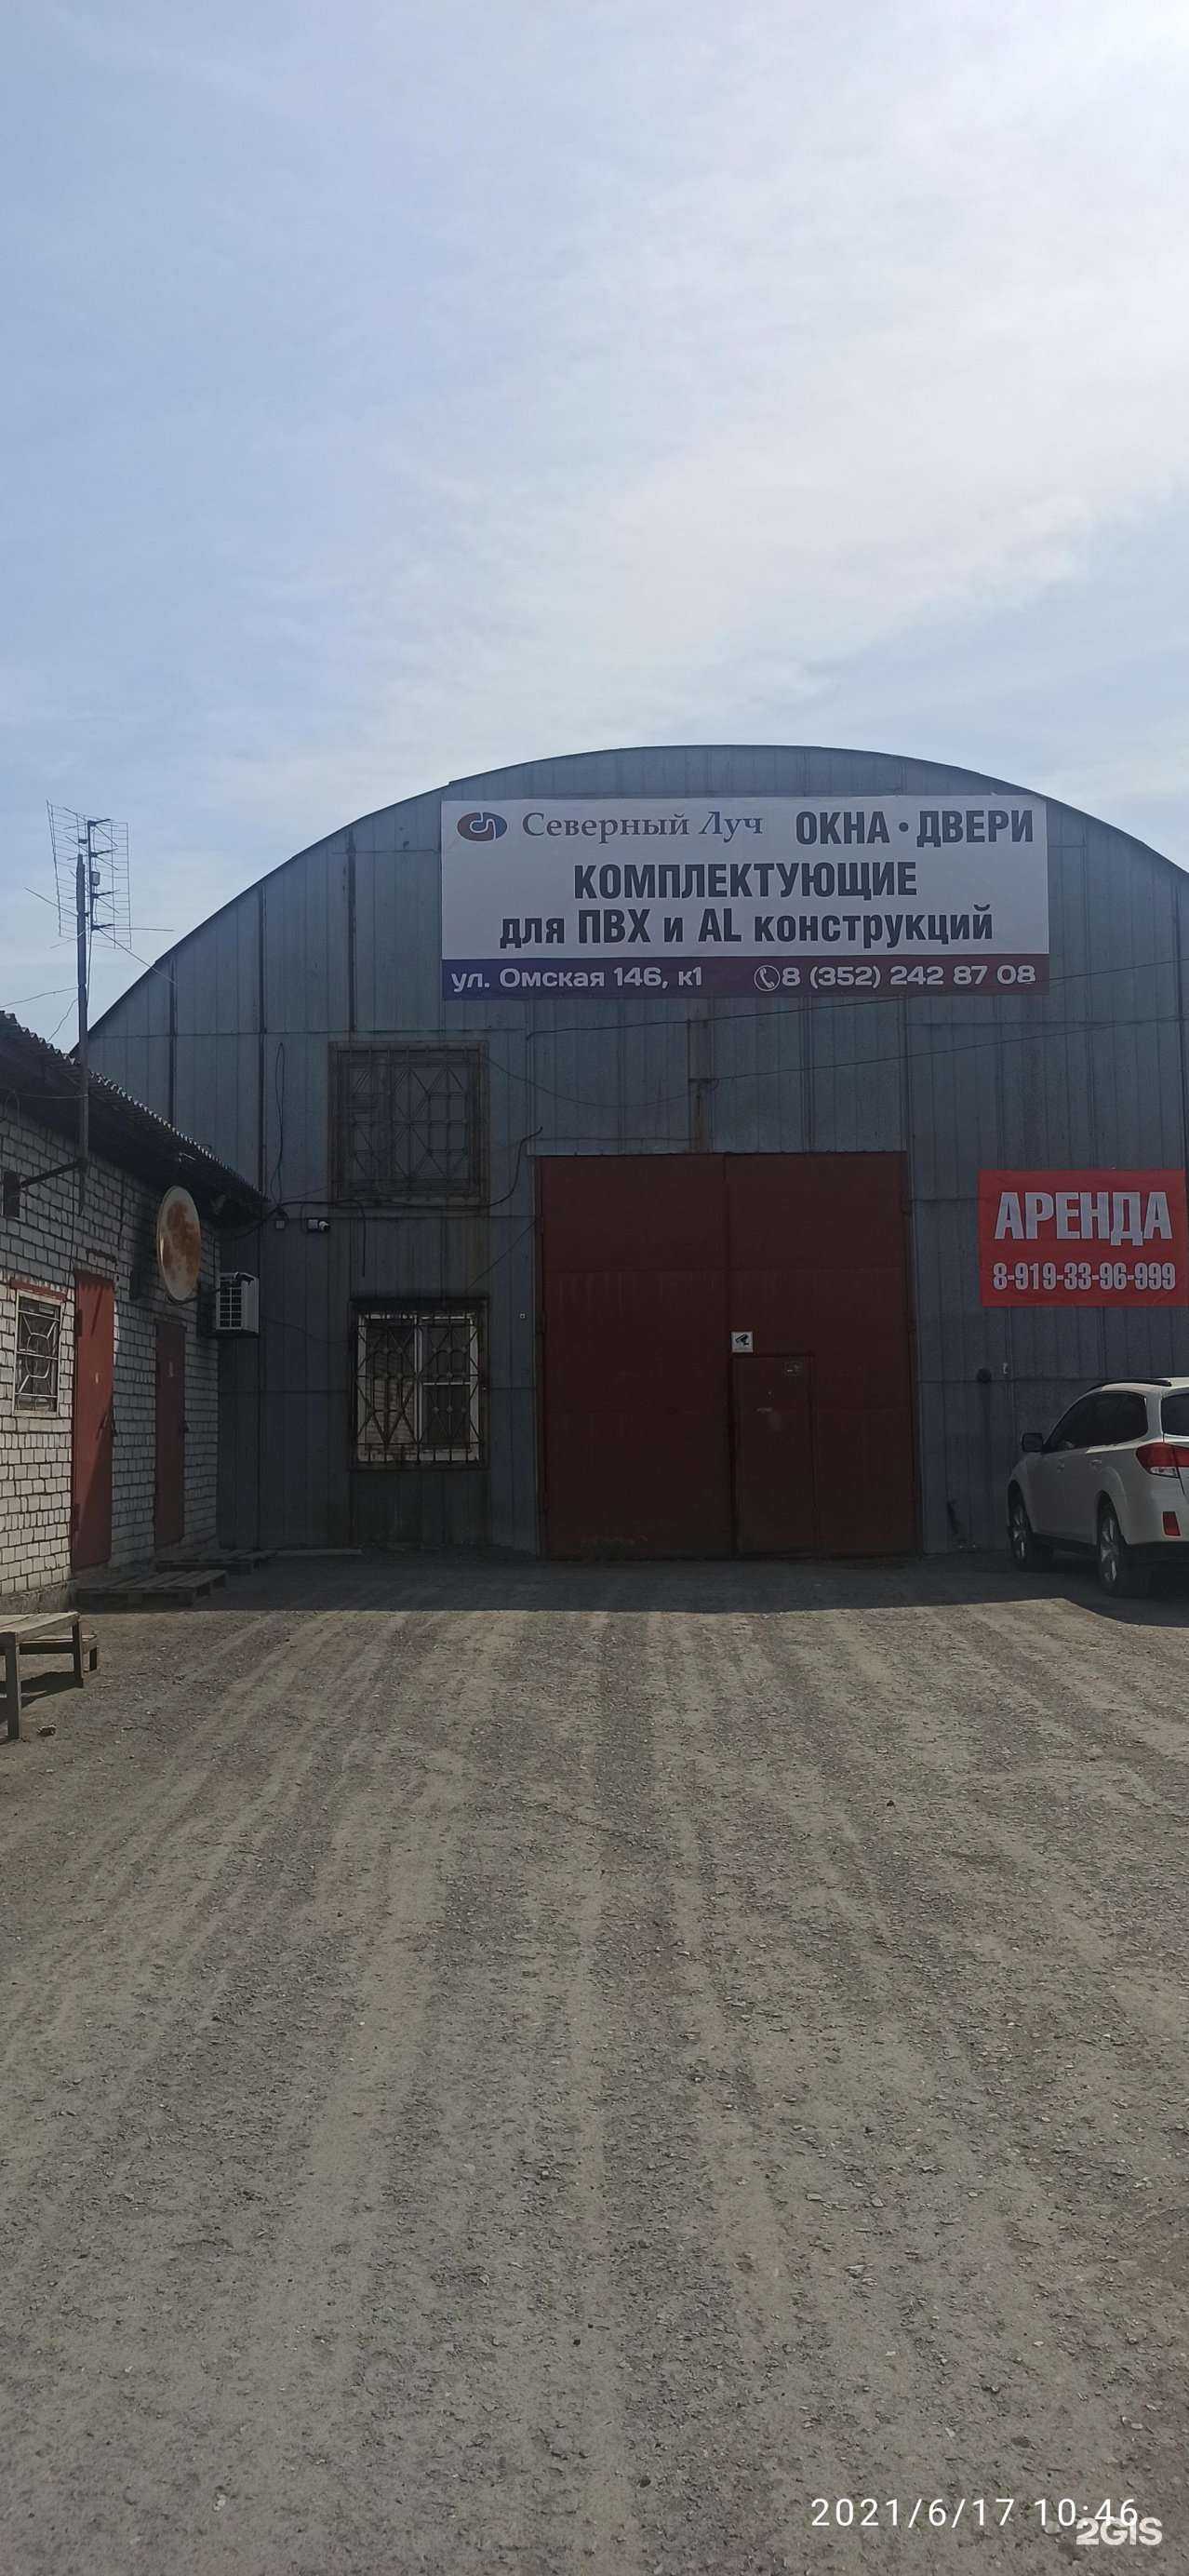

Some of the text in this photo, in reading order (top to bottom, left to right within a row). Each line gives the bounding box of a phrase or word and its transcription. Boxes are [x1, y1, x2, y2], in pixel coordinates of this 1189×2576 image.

[522, 812, 763, 844] Северный Луч
[795, 809, 1034, 848] ОКНА ДВЕРИ
[574, 861, 917, 901] КОМПЛЕКТУЮЩИЕ
[500, 918, 565, 949] для
[578, 908, 651, 944] ПВХ
[663, 917, 684, 943] и
[755, 904, 994, 949] конструкций
[451, 966, 702, 992] ул. Омская 146, к1
[782, 964, 1036, 989] 8 (352) 242 87 08
[994, 1191, 1173, 1246] АРЕНДА
[993, 1262, 1176, 1291] 8-919-33-96-999
